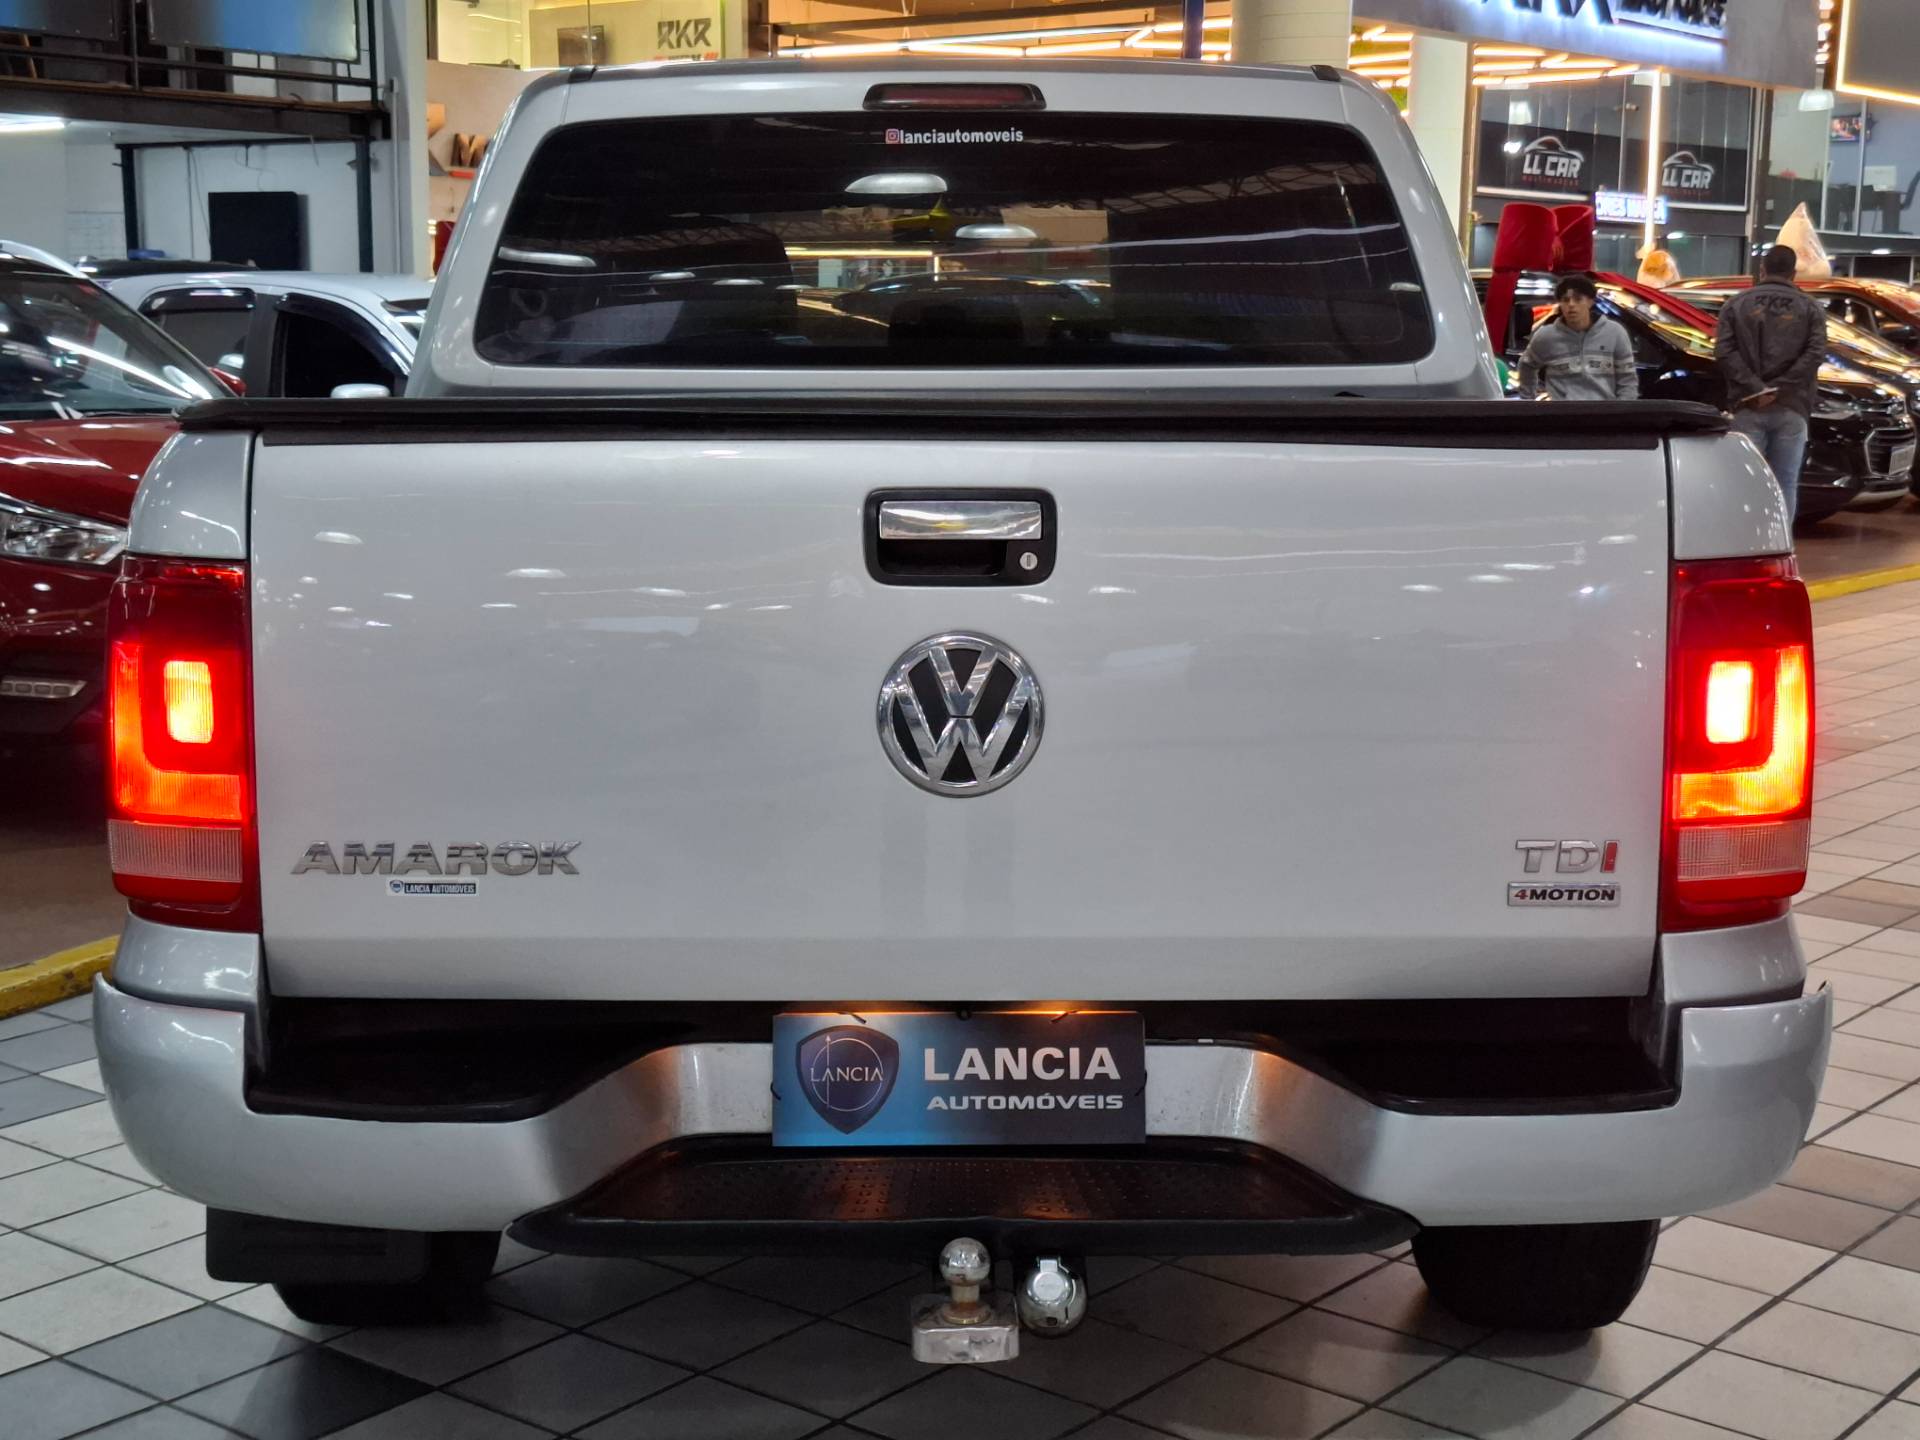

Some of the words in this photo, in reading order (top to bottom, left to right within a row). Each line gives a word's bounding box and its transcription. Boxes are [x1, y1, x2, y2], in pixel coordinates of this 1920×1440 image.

[657, 17, 712, 50] RKR
[900, 127, 1024, 144] lanciautomoveis
[1522, 153, 1542, 176] LL
[1544, 155, 1583, 178] CAR
[1661, 167, 1678, 188] LL
[1680, 169, 1713, 190] CAR
[290, 840, 582, 876] AMAROK
[1515, 839, 1620, 873] TDI
[406, 884, 431, 893] LANCIA
[1514, 888, 1616, 901] 4MOTION
[810, 1066, 884, 1083] LANCIA
[924, 1047, 1121, 1081] LANCIA
[926, 1092, 1123, 1111] AUTOMÓVEIS
